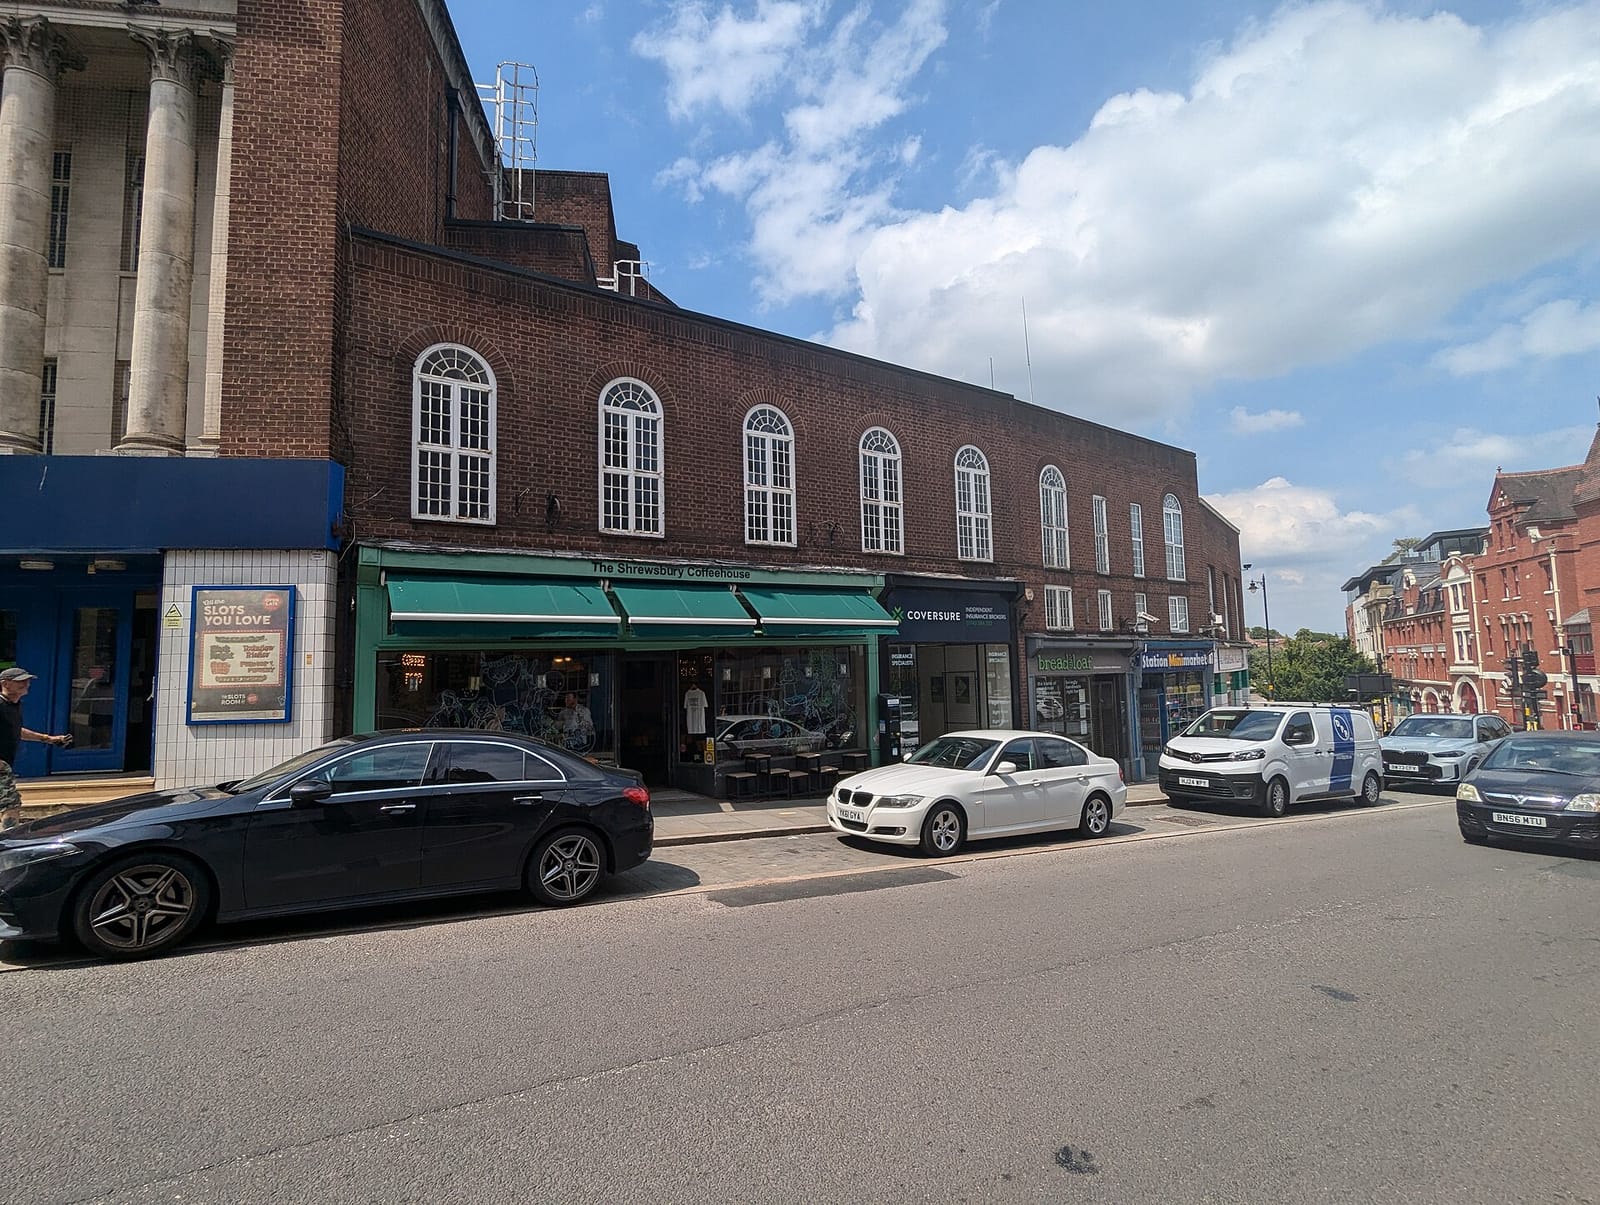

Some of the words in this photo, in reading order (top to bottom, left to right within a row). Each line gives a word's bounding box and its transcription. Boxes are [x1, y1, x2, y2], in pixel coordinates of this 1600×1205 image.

[592, 562, 614, 573] The
[617, 563, 684, 579] Shrewsbury
[687, 567, 751, 579] Coffeehouse
[203, 605, 245, 615] SLOTS
[907, 610, 961, 621] COVERSURE
[204, 615, 232, 626] YOU
[235, 615, 272, 625] LOVE
[1142, 653, 1168, 669] Station
[1496, 814, 1521, 823] BN56
